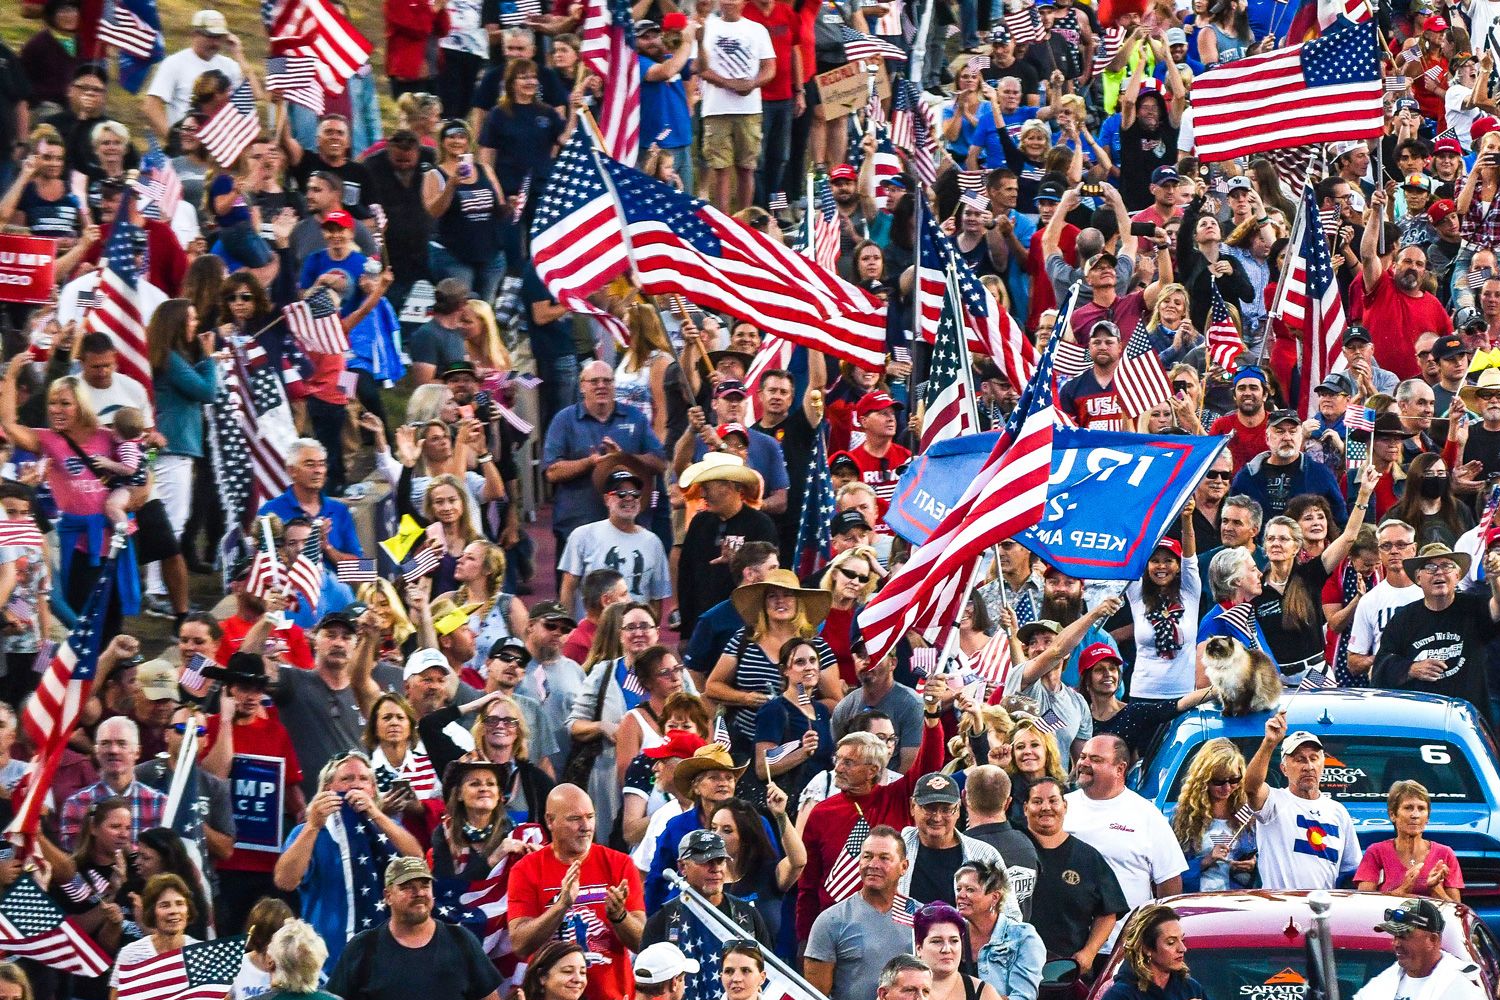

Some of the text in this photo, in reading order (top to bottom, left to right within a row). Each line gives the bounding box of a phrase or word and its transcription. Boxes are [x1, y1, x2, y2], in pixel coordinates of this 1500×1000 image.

[0, 252, 52, 268] UMP
[1087, 397, 1121, 416] USA
[1412, 635, 1435, 650] UNITED
[1420, 744, 1452, 764] 6
[1319, 775, 1358, 786] SINO
[1240, 984, 1306, 995] SARATO
